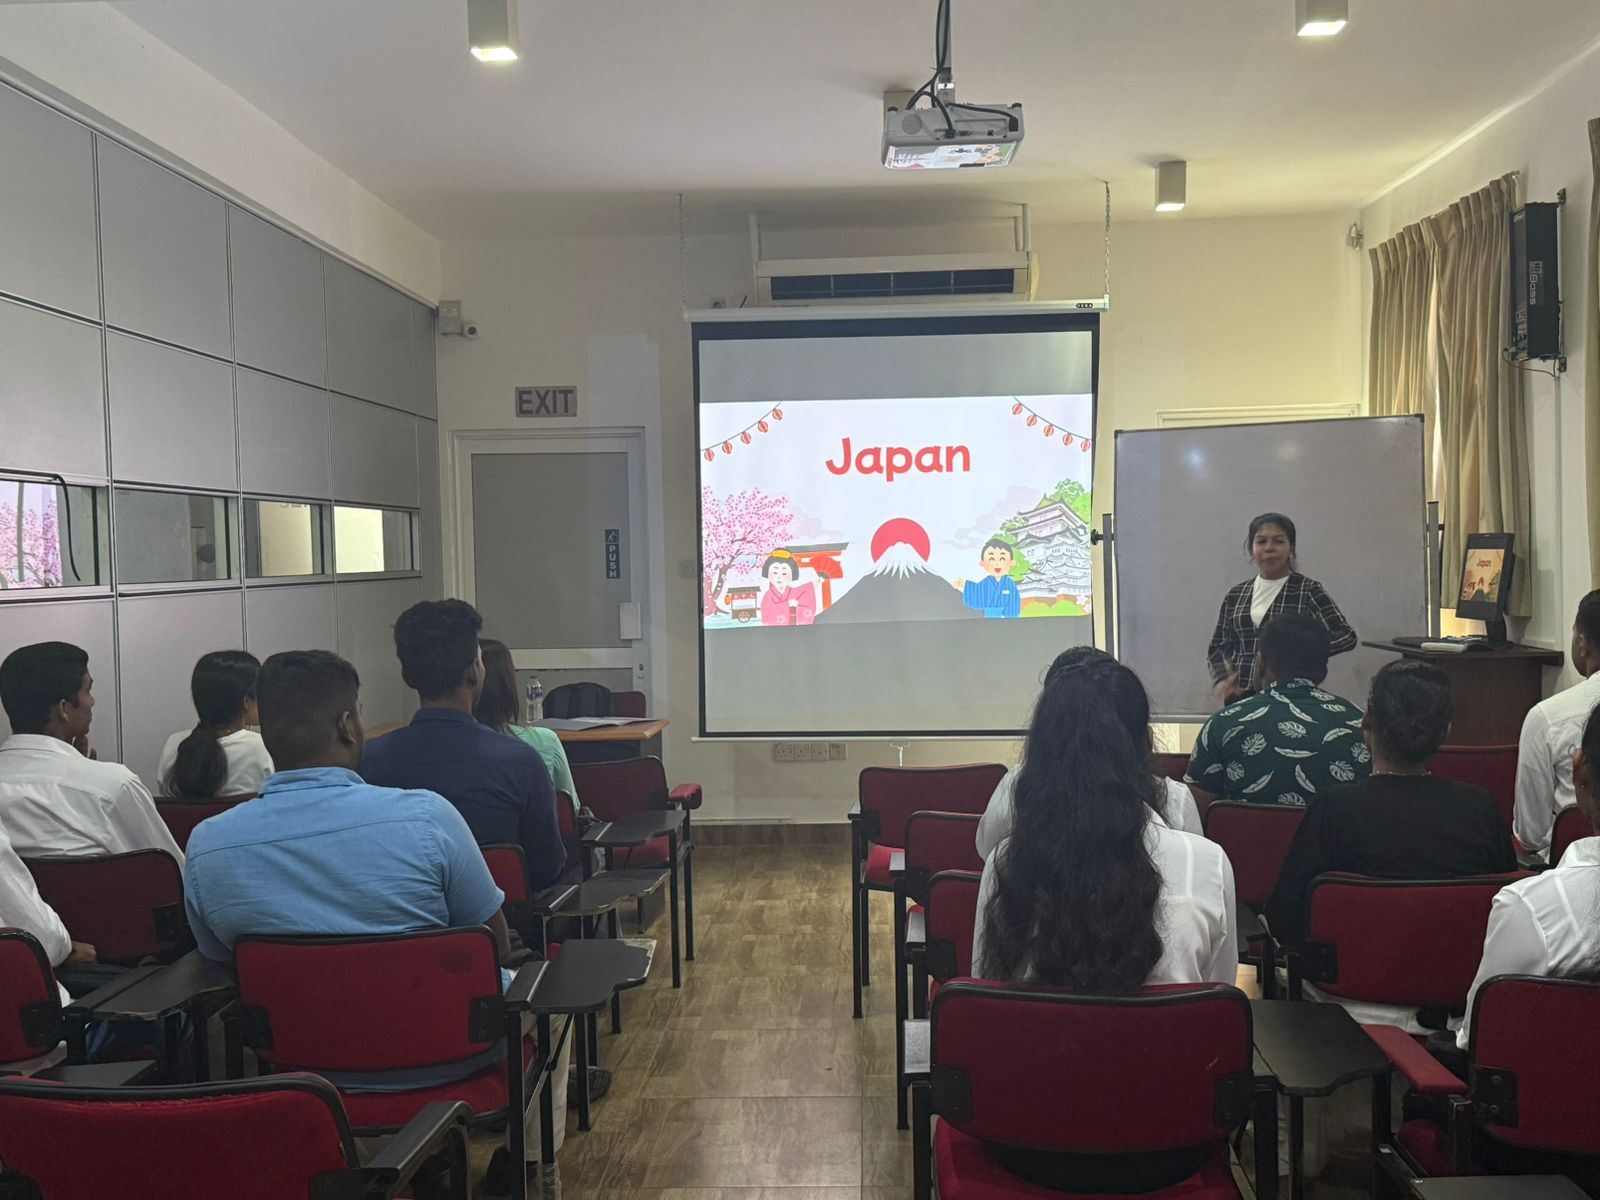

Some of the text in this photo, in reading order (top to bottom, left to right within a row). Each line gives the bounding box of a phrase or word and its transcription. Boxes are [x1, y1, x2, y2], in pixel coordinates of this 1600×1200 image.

[1529, 274, 1538, 305] Bass
[518, 389, 574, 415] EXIT
[825, 437, 971, 482] Japan
[609, 545, 617, 578] PUSH
